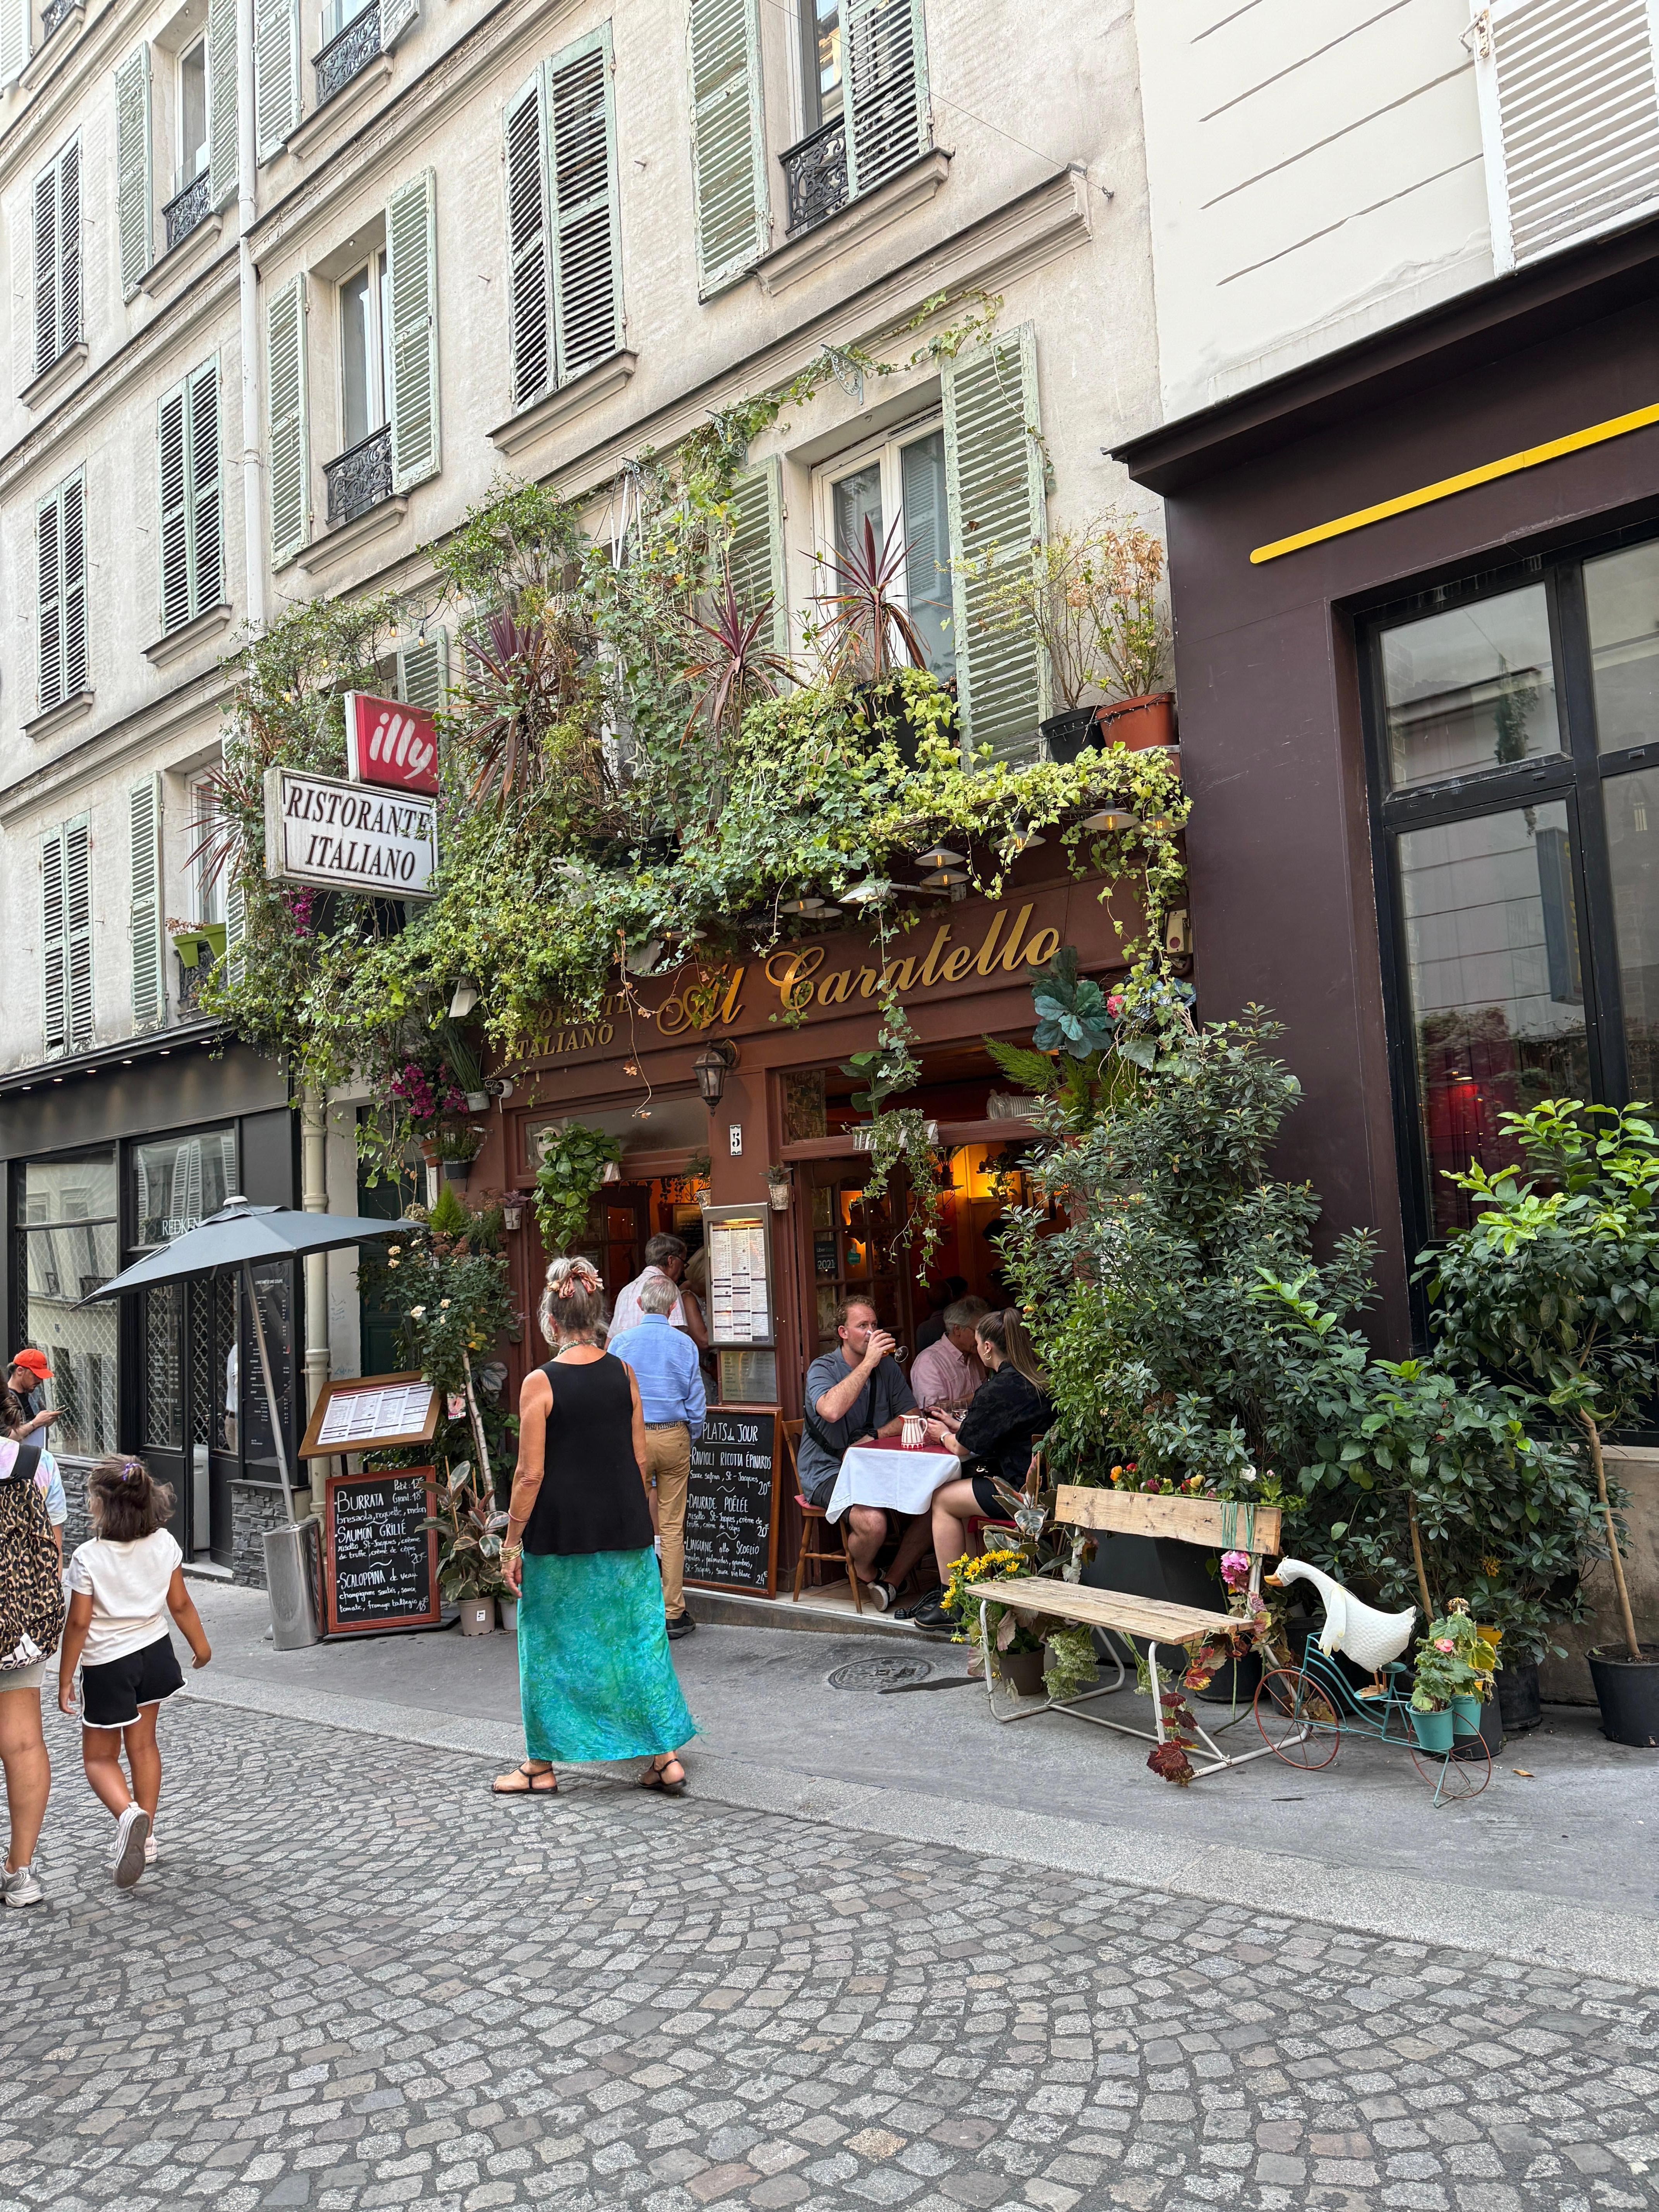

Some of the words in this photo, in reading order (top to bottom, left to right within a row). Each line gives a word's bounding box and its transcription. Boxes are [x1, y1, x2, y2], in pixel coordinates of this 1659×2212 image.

[369, 712, 433, 779] illy
[285, 786, 430, 842] RISTORANTE
[305, 834, 415, 881] ITALIANO
[765, 903, 1061, 1015] Caratello
[516, 1023, 614, 1060] TALIANO
[732, 1133, 740, 1147] 5
[162, 1217, 201, 1236] REDKEN
[817, 1260, 835, 1269] 2021
[702, 1422, 727, 1441] PLATS
[728, 1428, 735, 1441] du
[737, 1424, 758, 1442] JOUR
[721, 1451, 743, 1467] RICOTTA
[757, 1481, 771, 1495] 20€
[338, 1491, 383, 1513] BURRATA
[407, 1503, 426, 1514] melon
[689, 1493, 717, 1510] DAURADE
[724, 1495, 748, 1512] POÊLÉE
[338, 1526, 372, 1543] SAUMON
[757, 1523, 769, 1537] 20€
[338, 1542, 358, 1552] risotto
[686, 1536, 713, 1552] LINGUINE
[736, 1540, 760, 1555] SCOGLIO
[340, 1570, 385, 1589] SCALOPPINA
[390, 1568, 398, 1581] de
[756, 1571, 768, 1585] 24€
[0, 1652, 47, 1671] didas
